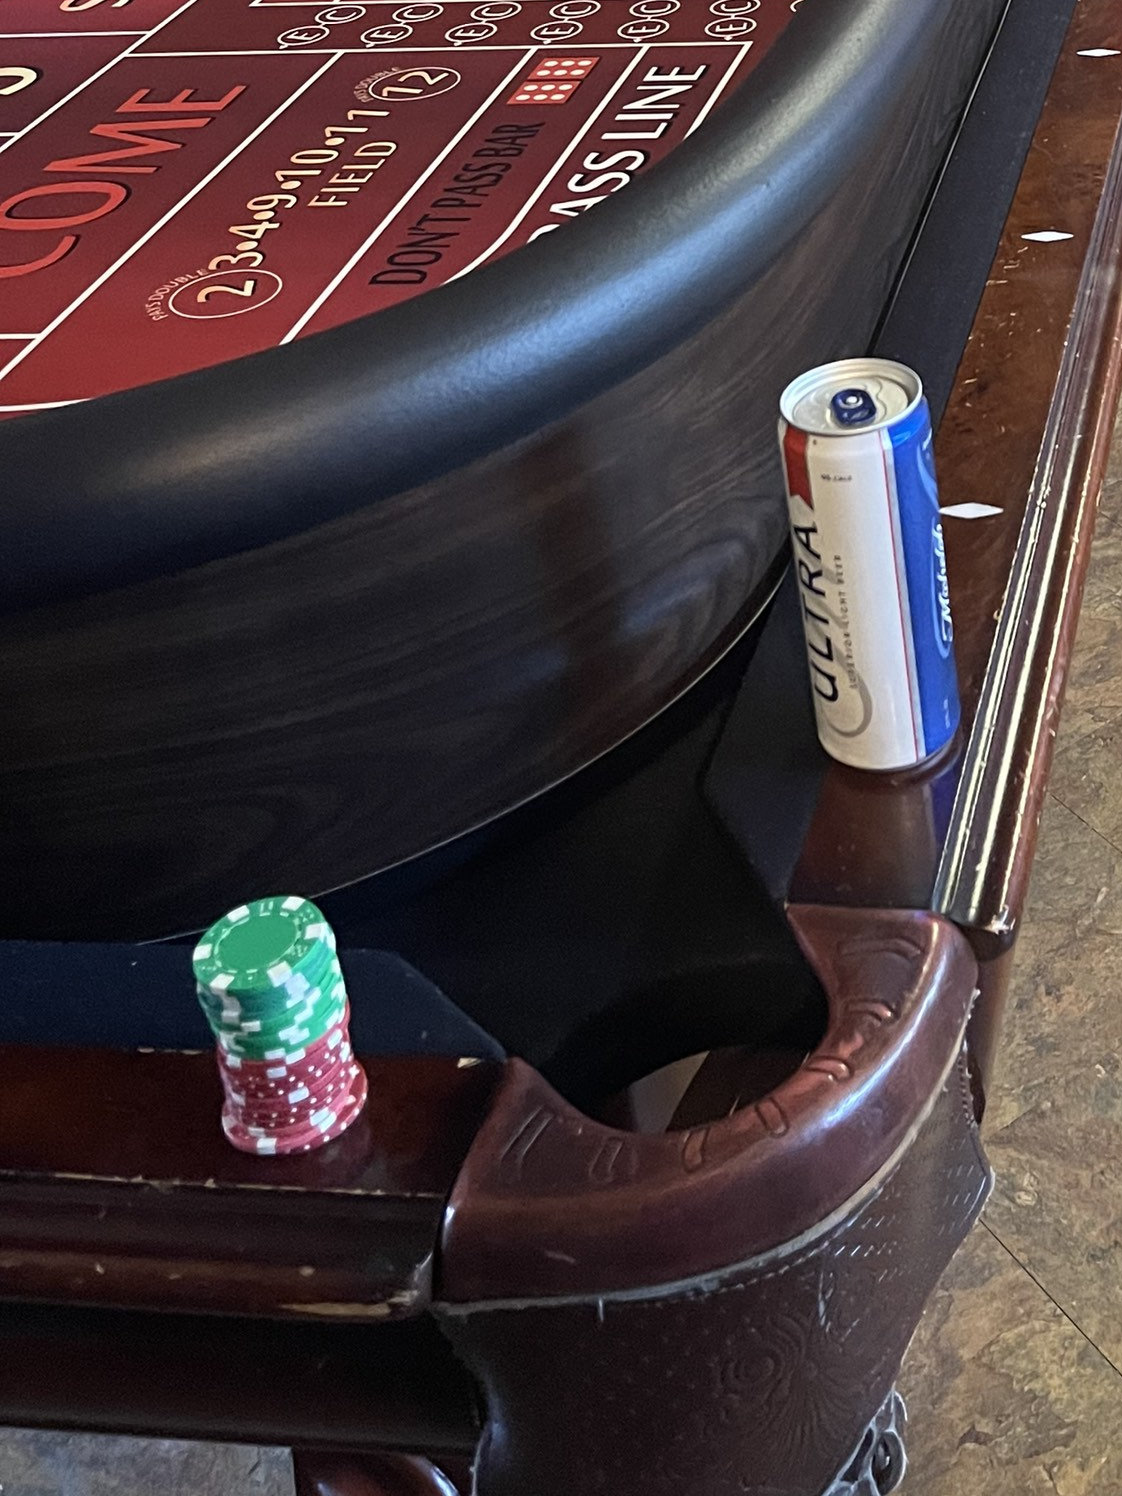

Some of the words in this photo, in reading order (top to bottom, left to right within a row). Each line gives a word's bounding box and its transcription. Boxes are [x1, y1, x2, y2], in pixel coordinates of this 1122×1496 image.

[382, 71, 449, 97] 12
[308, 142, 397, 207] FIELD
[527, 150, 646, 244] ASS
[601, 64, 707, 141] LINE
[369, 213, 472, 287] DON'T
[431, 162, 513, 208] PASS
[472, 122, 546, 158] BAR
[148, 269, 209, 301] DOUBLE
[197, 280, 254, 303] 2
[793, 521, 839, 702] ULTRA
